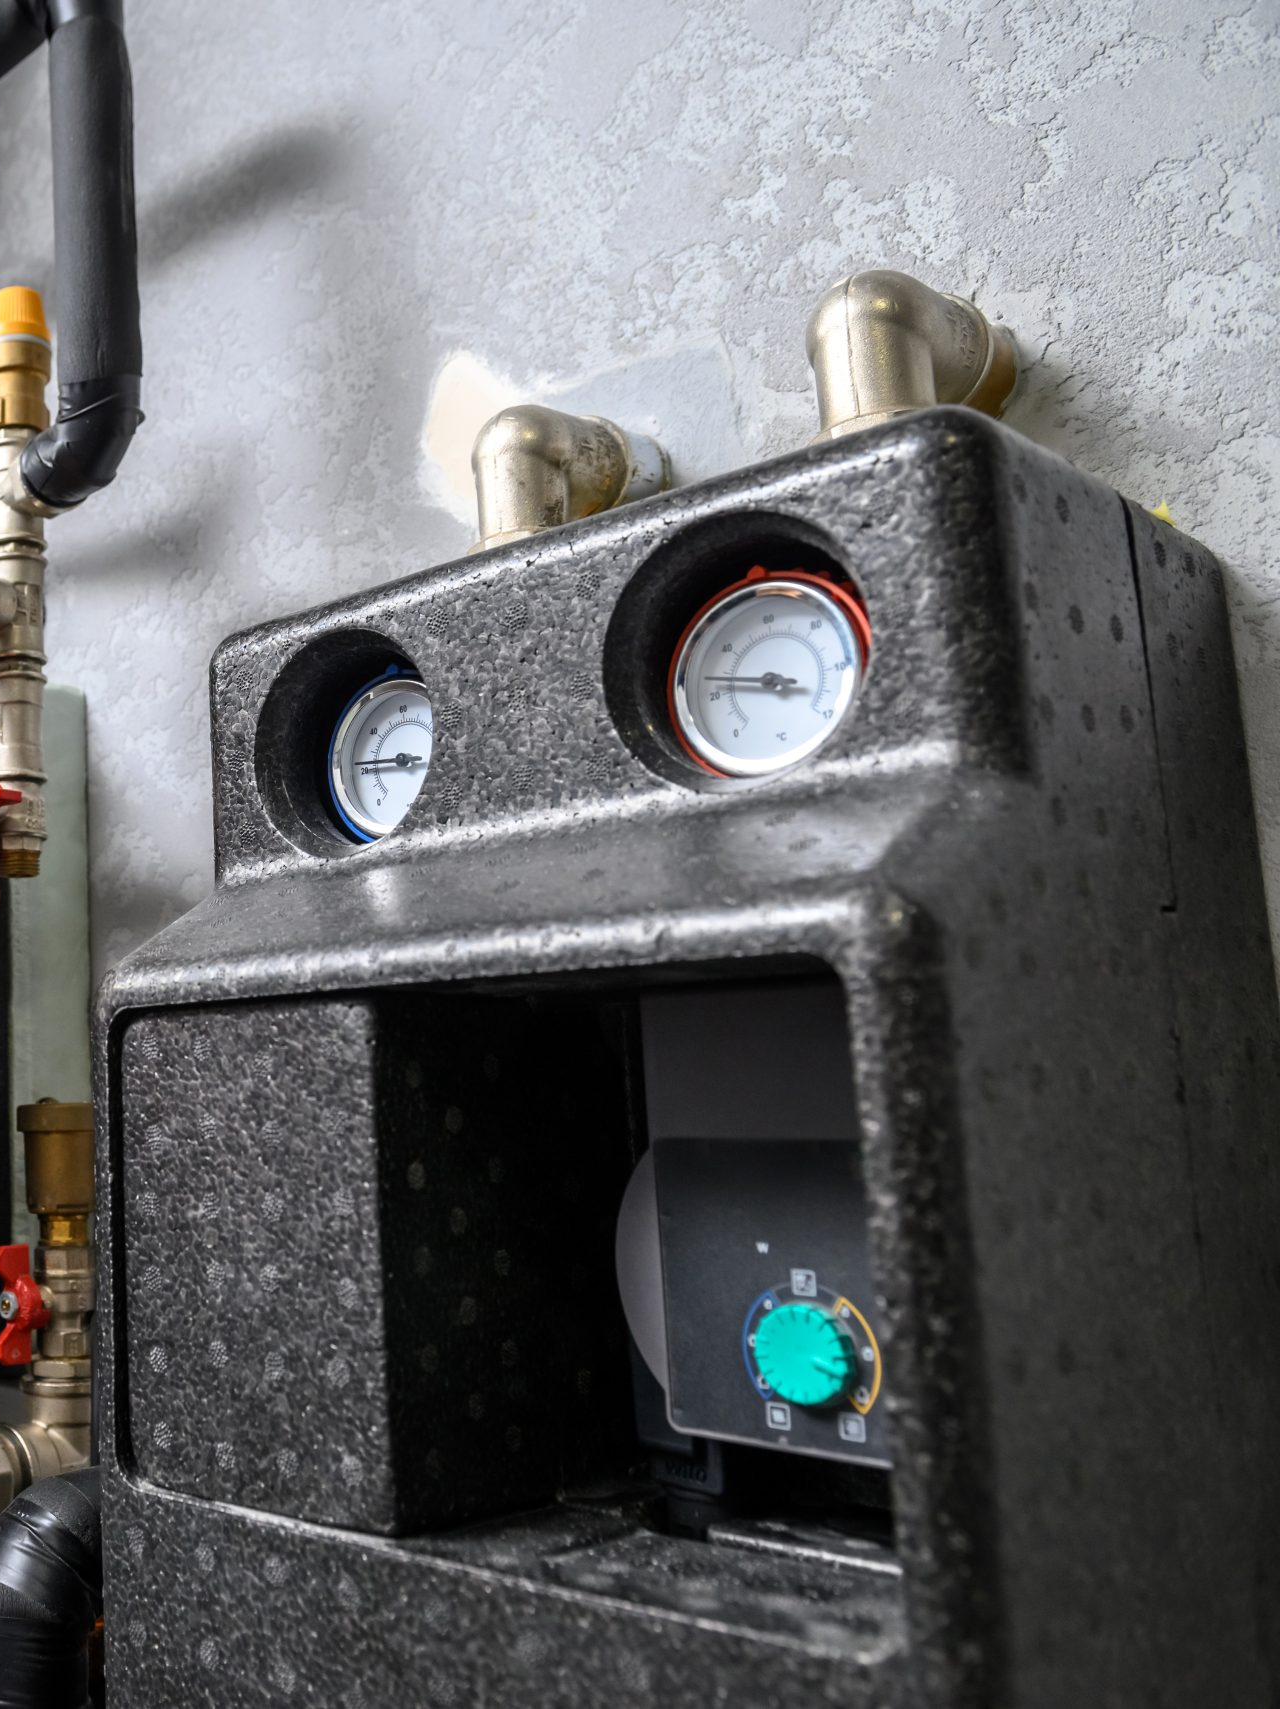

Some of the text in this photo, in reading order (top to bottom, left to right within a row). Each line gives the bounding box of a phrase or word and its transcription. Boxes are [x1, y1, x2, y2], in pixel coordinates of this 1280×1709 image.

[763, 615, 775, 624] 60
[722, 644, 733, 653] 40
[710, 692, 720, 701] 20
[399, 705, 408, 713] 60
[733, 729, 739, 738] 0
[361, 767, 369, 775] 20
